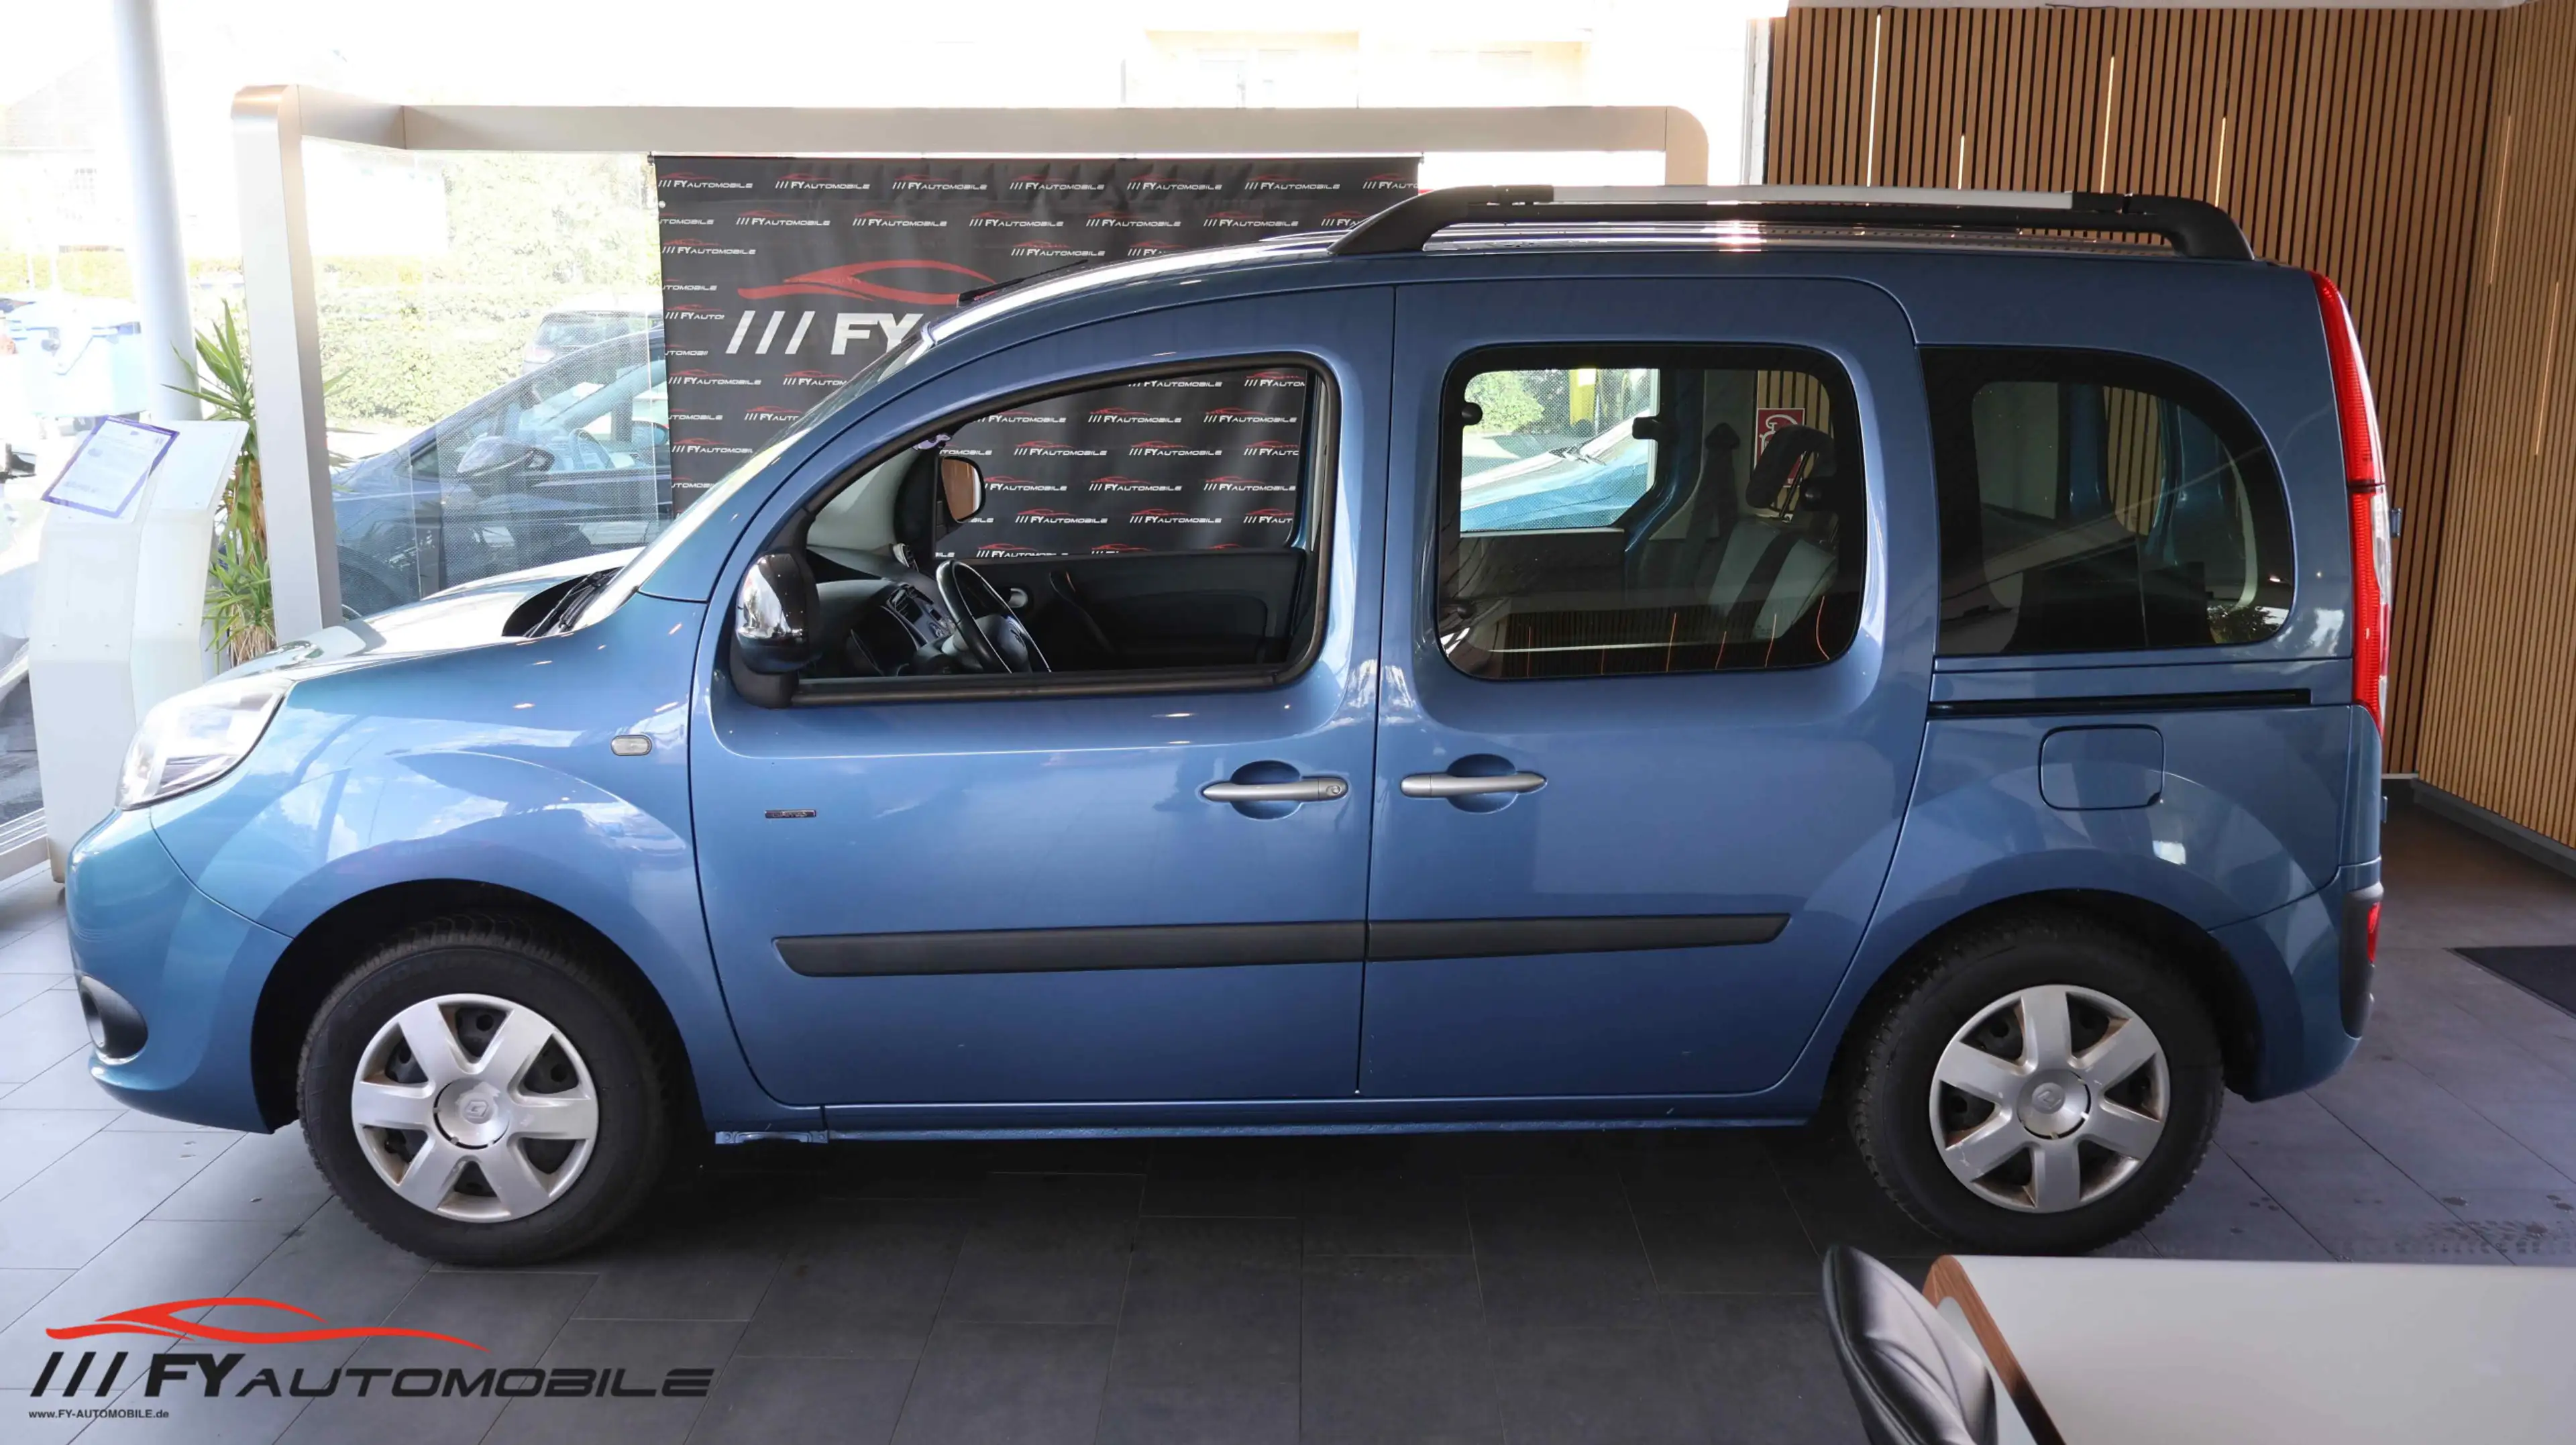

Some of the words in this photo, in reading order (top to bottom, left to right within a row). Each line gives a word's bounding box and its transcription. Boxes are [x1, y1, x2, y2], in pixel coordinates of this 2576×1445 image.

[674, 180, 753, 189] FYAUTOMOBILE
[790, 180, 871, 190] FYAUTOMOBILE
[908, 182, 987, 190] FYAUTOMOBILE
[1025, 182, 1105, 191] FYAUTOMOBILE
[1142, 182, 1222, 191] FYAUTOMOBILE
[1260, 182, 1340, 190] FYAUTOMOBILE
[751, 217, 830, 226] FYAUTOMOBILE
[868, 218, 947, 227] FYAUTOMOBILE
[985, 219, 1064, 227] FYAUTOMOBILE
[1102, 219, 1181, 227] FYAUTOMOBILE
[1219, 219, 1299, 227] FYAUTOMOBILE
[677, 246, 757, 255] FYAUTOMOBILE
[1026, 248, 1106, 256] FYAUTOMOBILE
[684, 376, 762, 385] FYAUTOMOBILE
[988, 415, 1067, 423] FYAUTOMOBILE
[1104, 415, 1182, 423] FYAUTOMOBILE
[1219, 415, 1297, 423] FYAUTOMOBILE
[1029, 447, 1108, 456] FYAUTOMOBILE
[1144, 448, 1223, 456] FYAUTOMOBILE
[989, 483, 1067, 491] FYAUTOMOBILE
[1104, 483, 1182, 491] FYAUTOMOBILE
[1030, 515, 1108, 524] FYAUTOMOBILE
[1144, 516, 1223, 524] FYAUTOMOBILE
